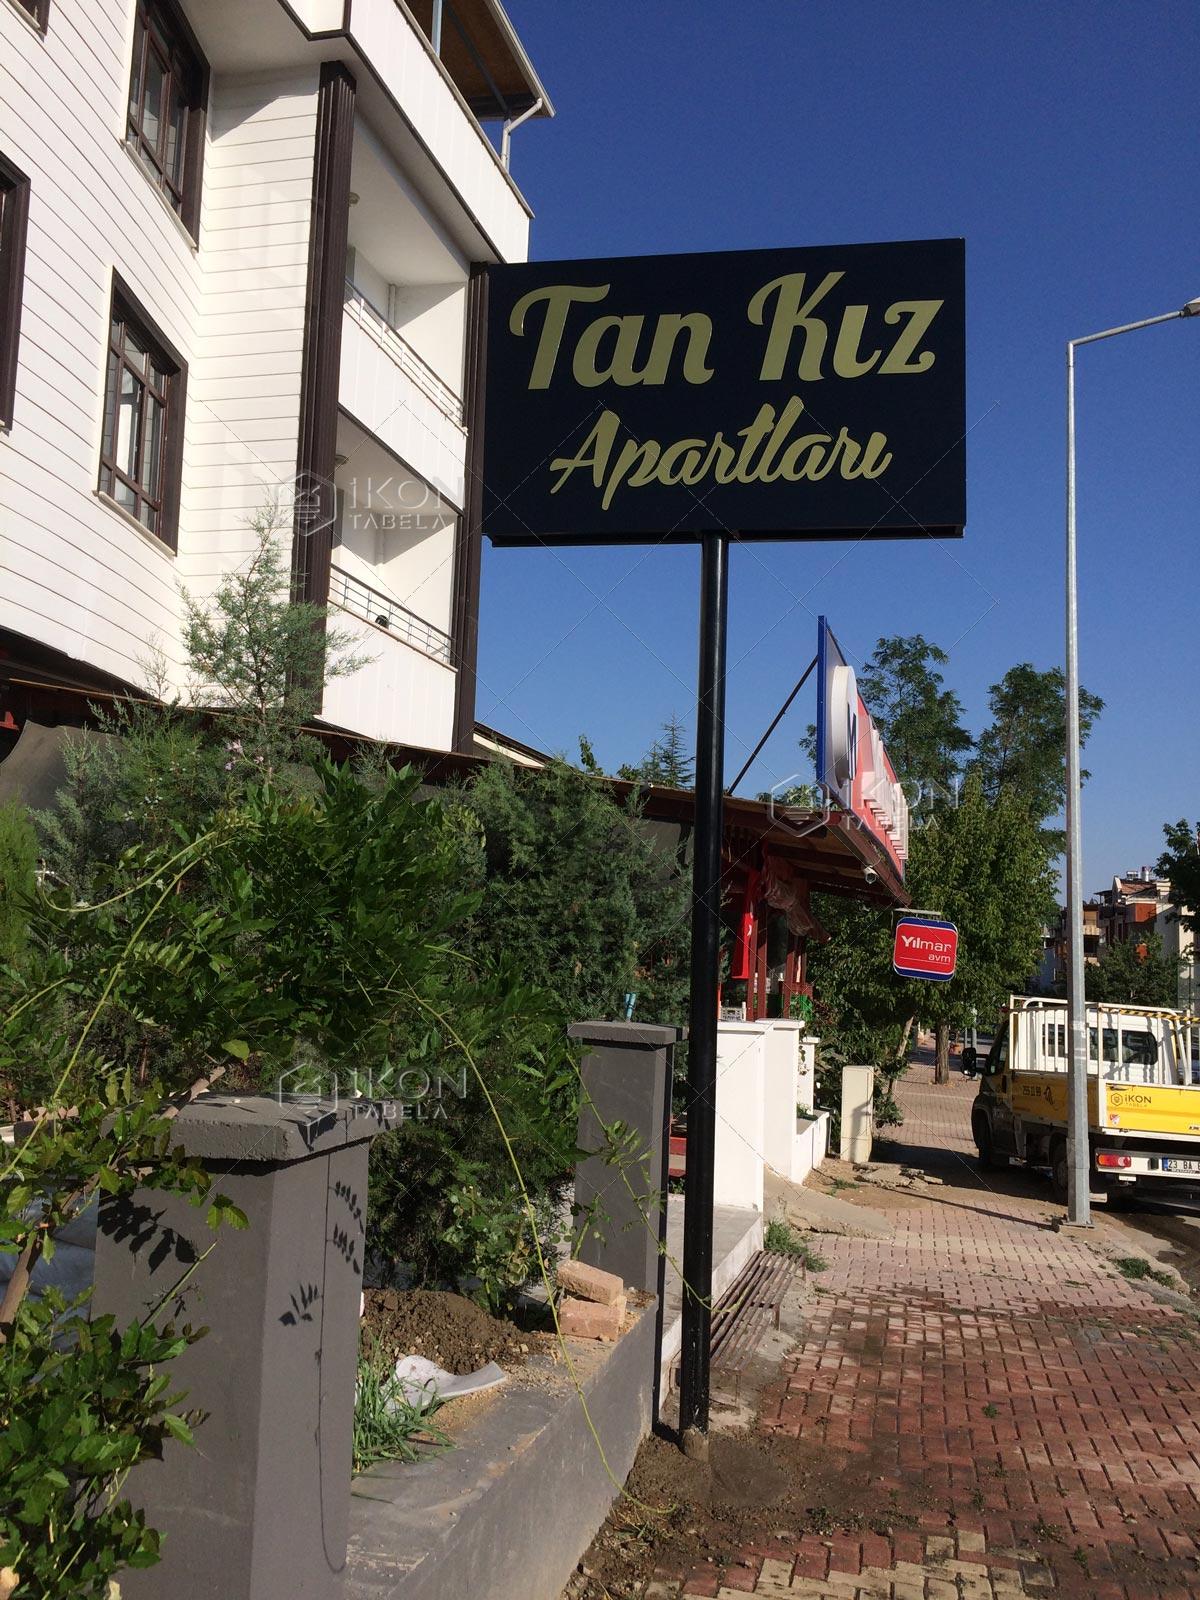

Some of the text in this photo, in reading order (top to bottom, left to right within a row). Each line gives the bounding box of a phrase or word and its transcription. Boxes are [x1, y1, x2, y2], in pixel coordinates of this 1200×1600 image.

[508, 271, 945, 390] Tan Kız
[549, 395, 893, 511] Apartları
[928, 953, 951, 963] avm
